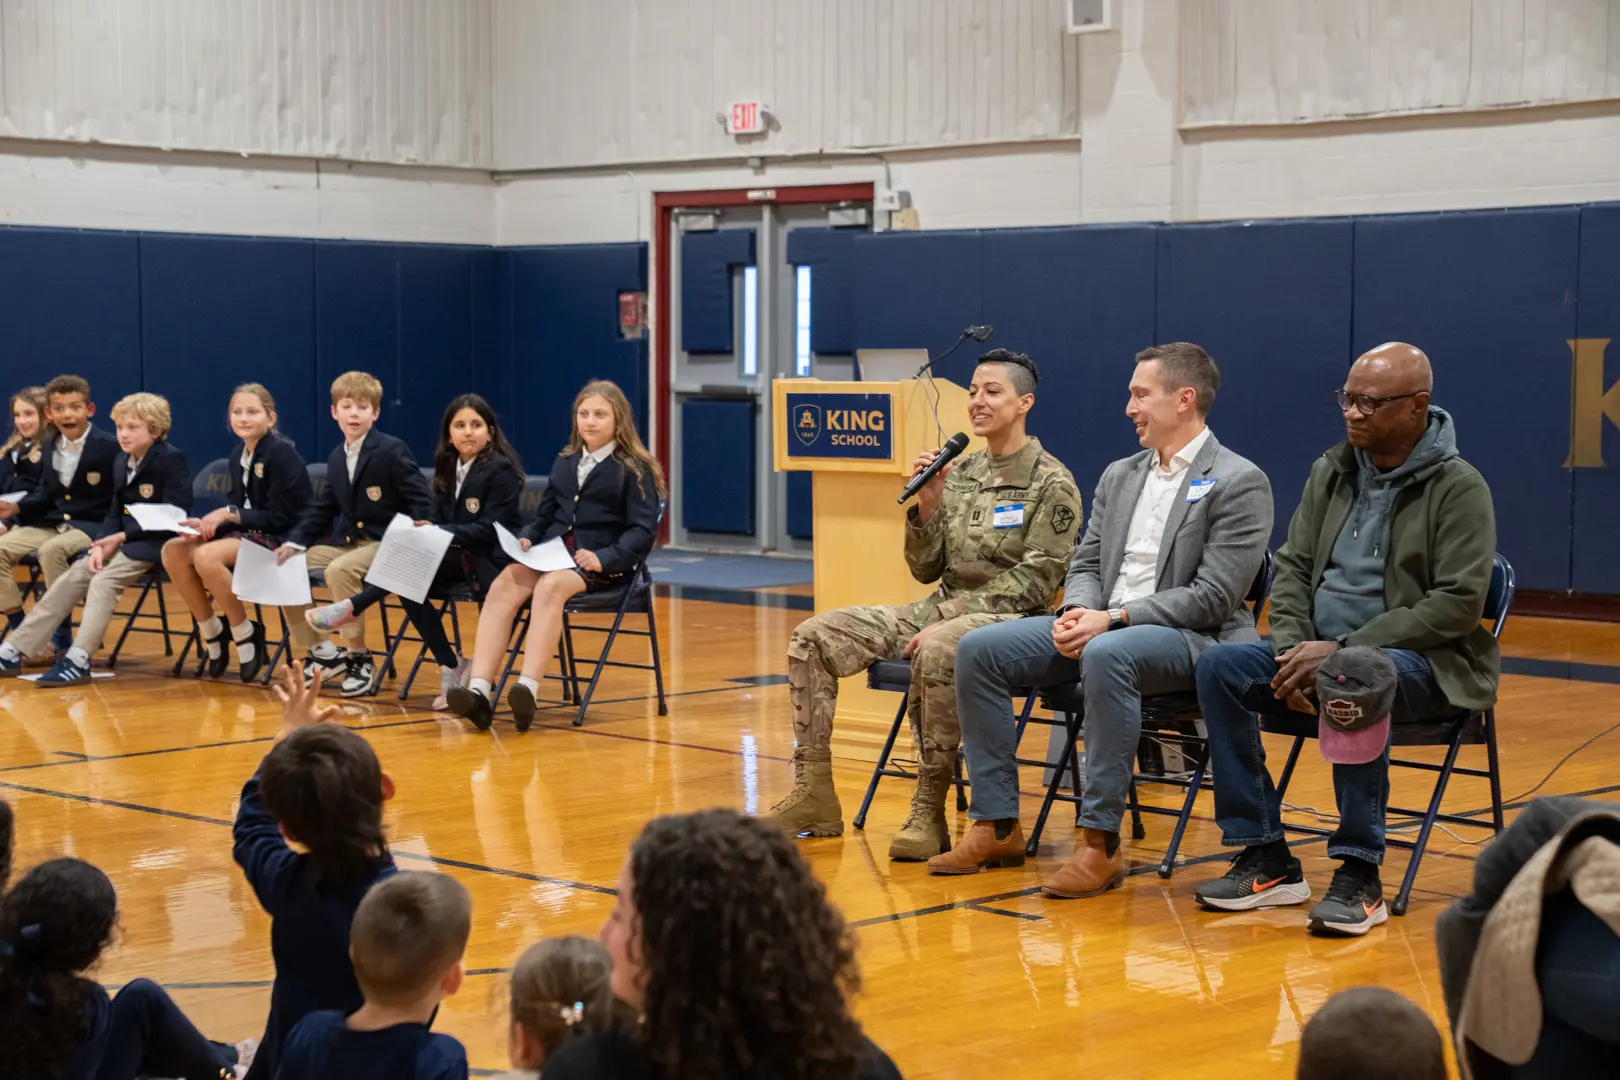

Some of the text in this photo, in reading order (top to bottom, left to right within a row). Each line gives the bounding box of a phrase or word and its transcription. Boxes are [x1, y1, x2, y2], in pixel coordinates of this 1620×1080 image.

[733, 103, 758, 131] EXIT
[826, 410, 885, 431] KING
[831, 434, 881, 447] SCHOOL
[1012, 490, 1029, 500] ARMY
